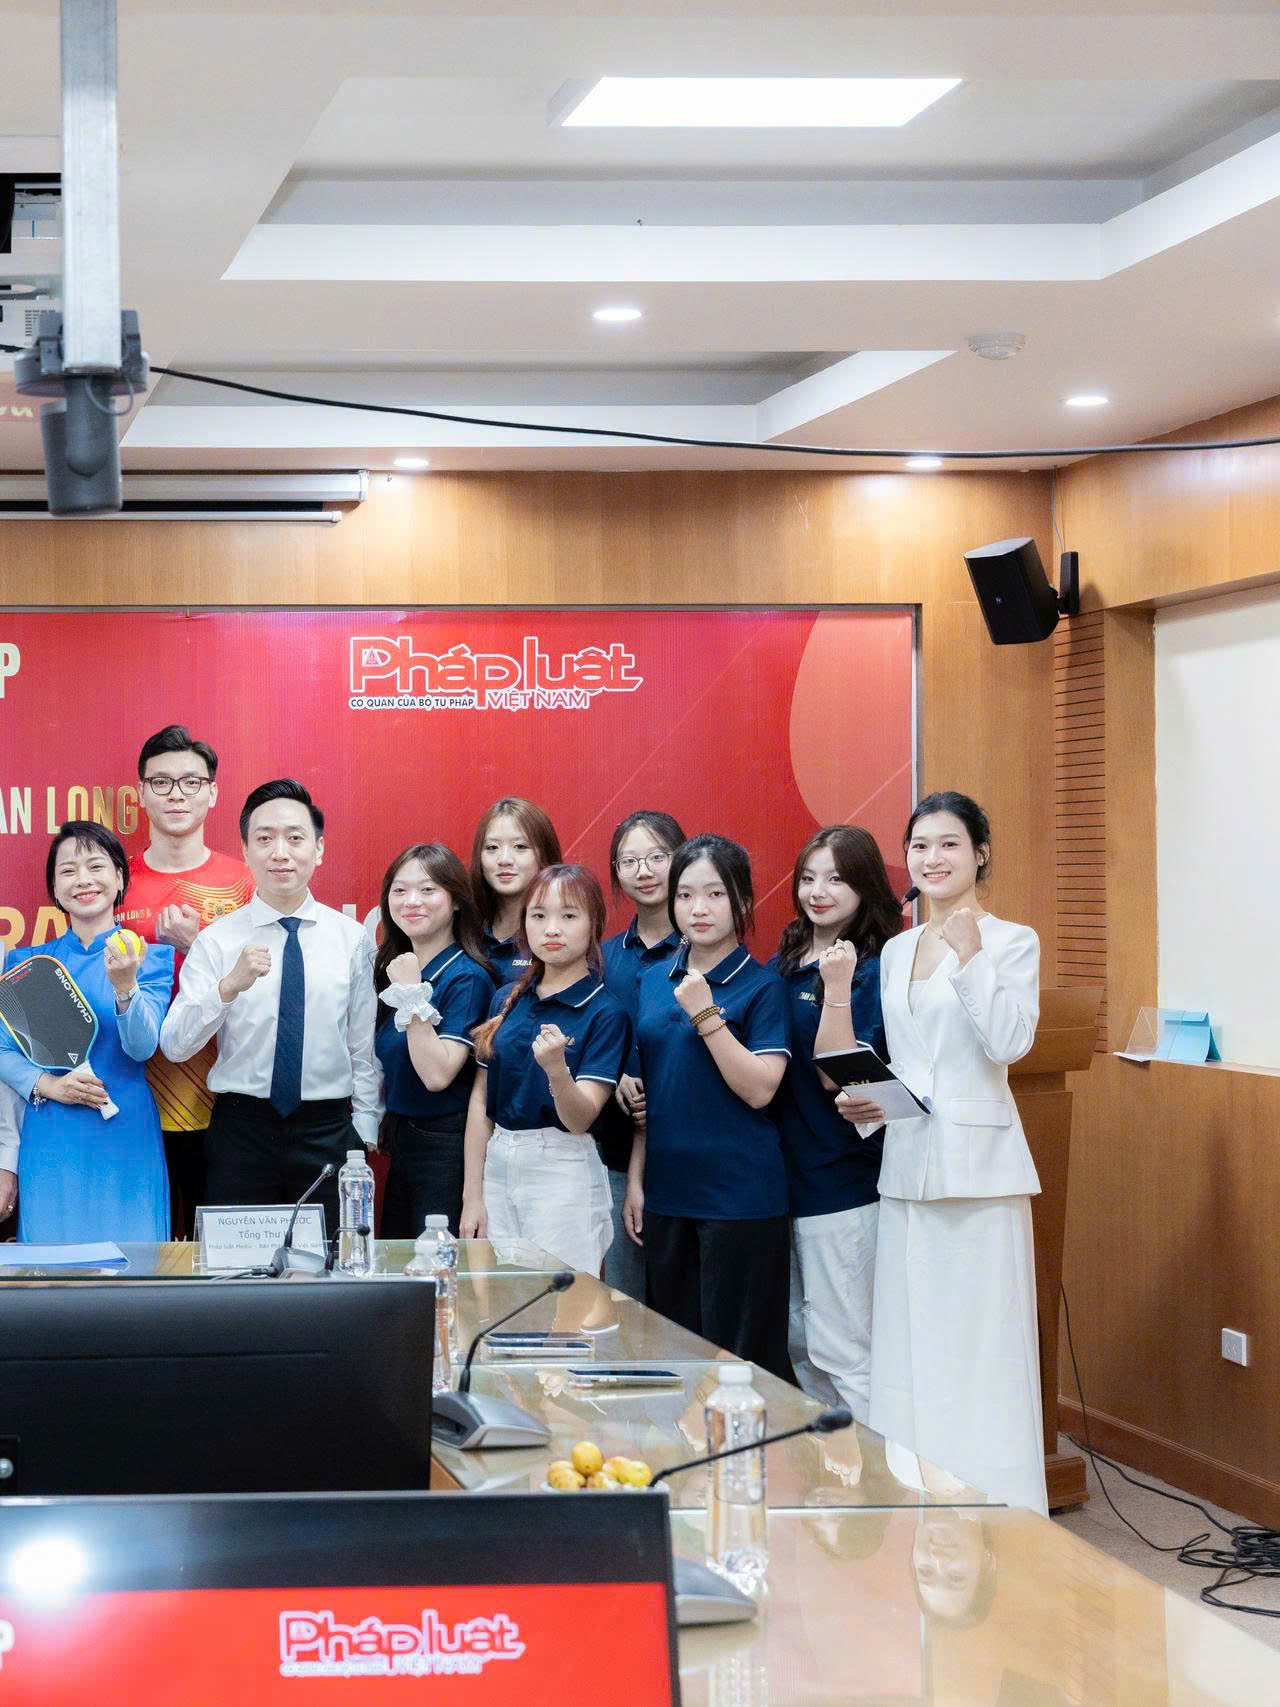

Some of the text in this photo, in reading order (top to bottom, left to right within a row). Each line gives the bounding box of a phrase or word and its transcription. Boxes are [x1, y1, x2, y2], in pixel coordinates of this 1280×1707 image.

[367, 698, 395, 708] QUAN
[449, 695, 474, 707] PHÁP
[486, 688, 590, 712] VIỆT NAM
[47, 786, 139, 834] LONG
[54, 968, 93, 1023] CHANLONG
